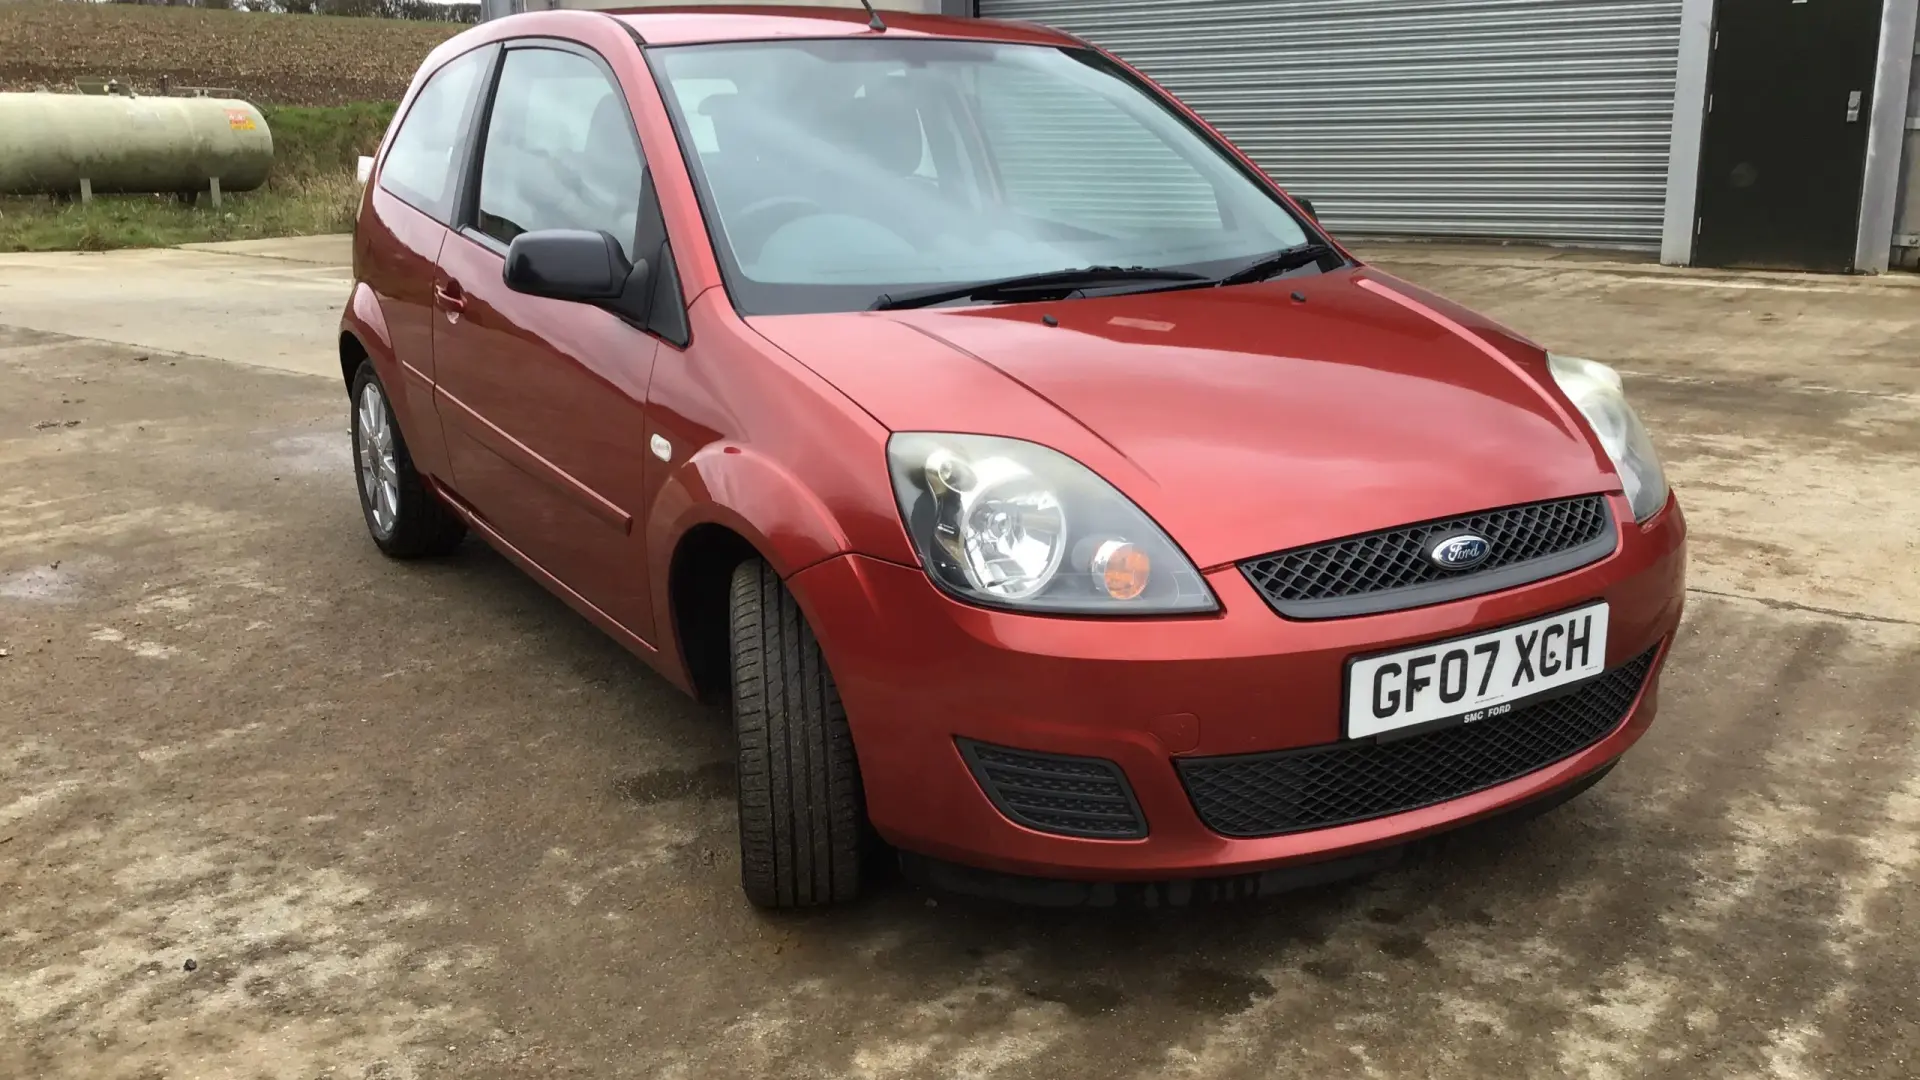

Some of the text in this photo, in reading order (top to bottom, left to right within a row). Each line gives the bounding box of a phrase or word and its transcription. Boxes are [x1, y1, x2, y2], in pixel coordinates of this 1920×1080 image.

[1448, 541, 1479, 561] Ford
[1372, 615, 1592, 719] GF07 XCH
[1464, 704, 1511, 723] SMC FORD
